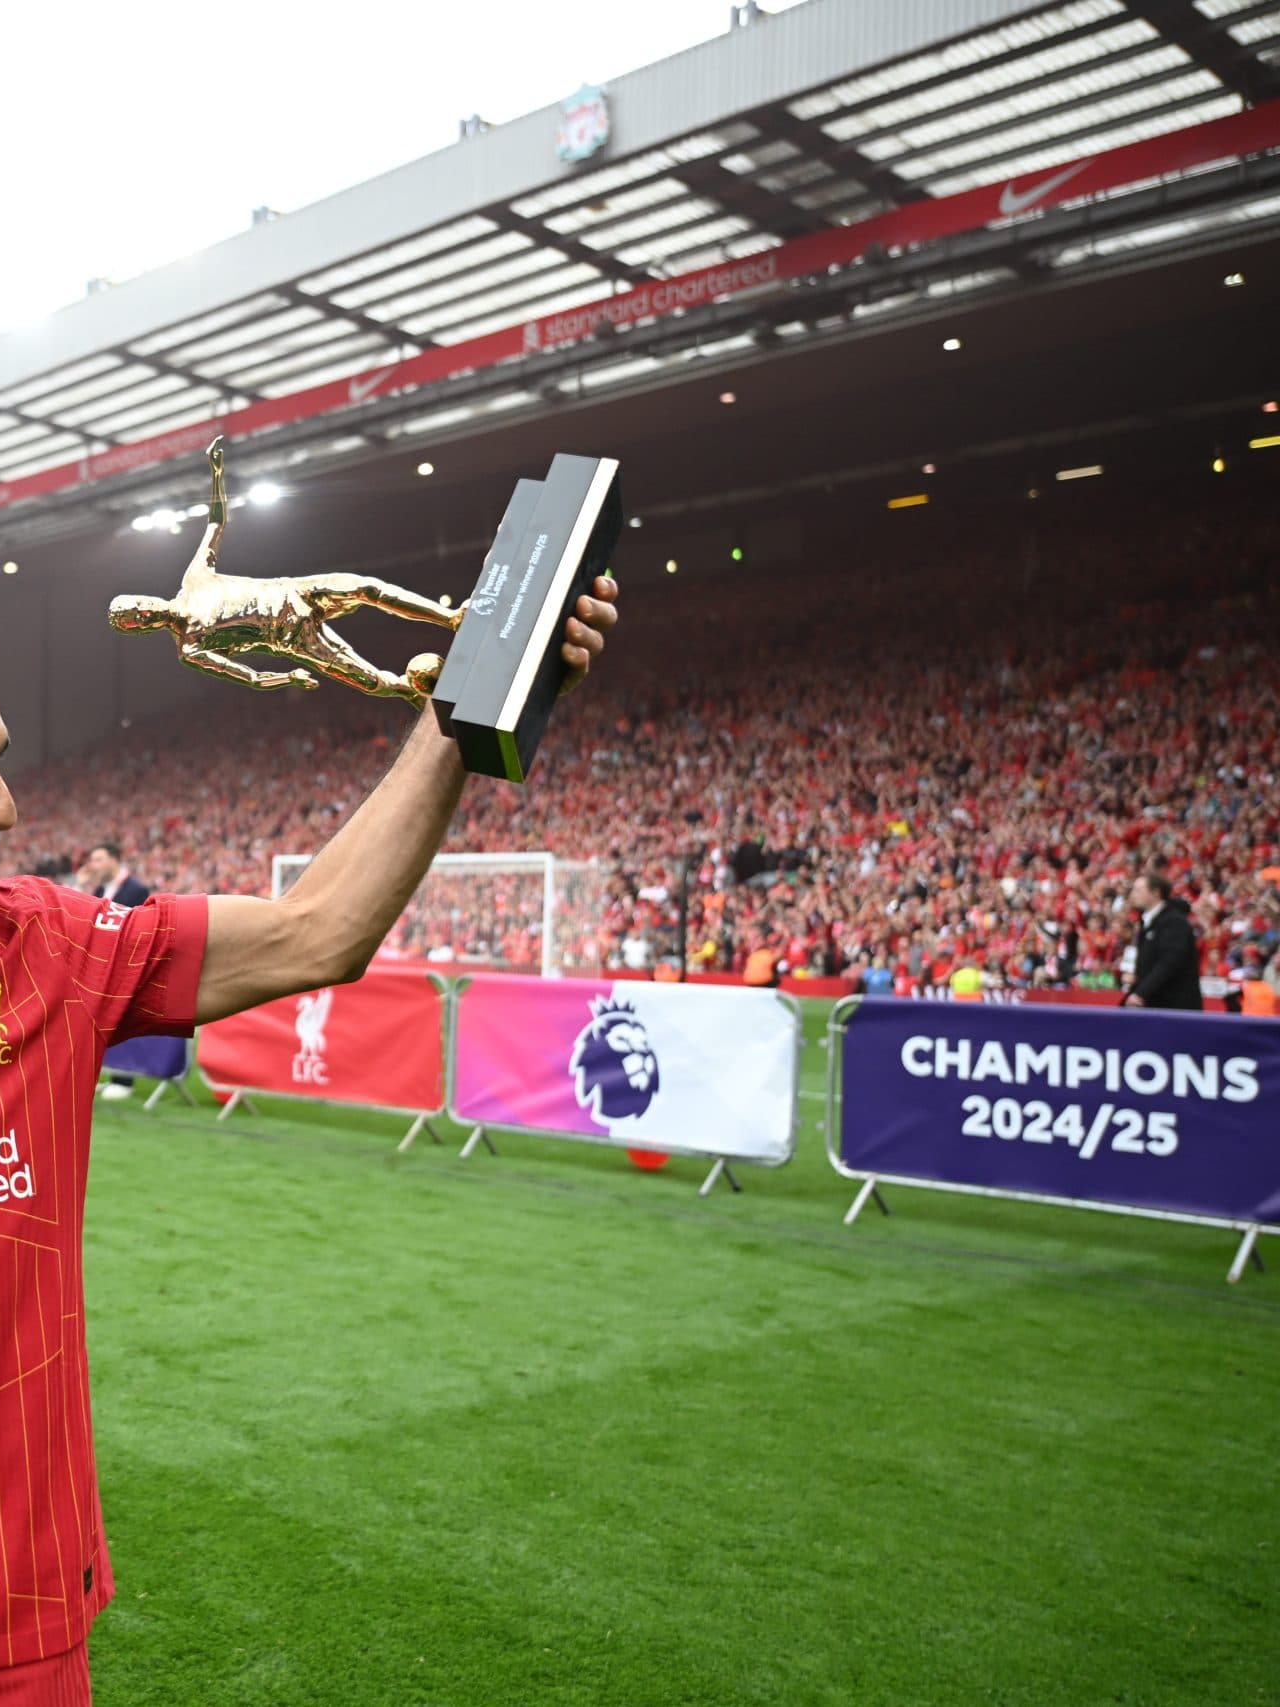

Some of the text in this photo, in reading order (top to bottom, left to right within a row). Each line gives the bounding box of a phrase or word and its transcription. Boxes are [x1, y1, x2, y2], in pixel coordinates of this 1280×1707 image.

[545, 256, 776, 336] standard chartered
[480, 562, 500, 595] Premier
[492, 564, 510, 597] League
[499, 533, 548, 639] Playmaker winner 2024/25
[900, 1035, 1260, 1103] CHAMPIONS
[961, 1095, 1179, 1160] 2024/25
